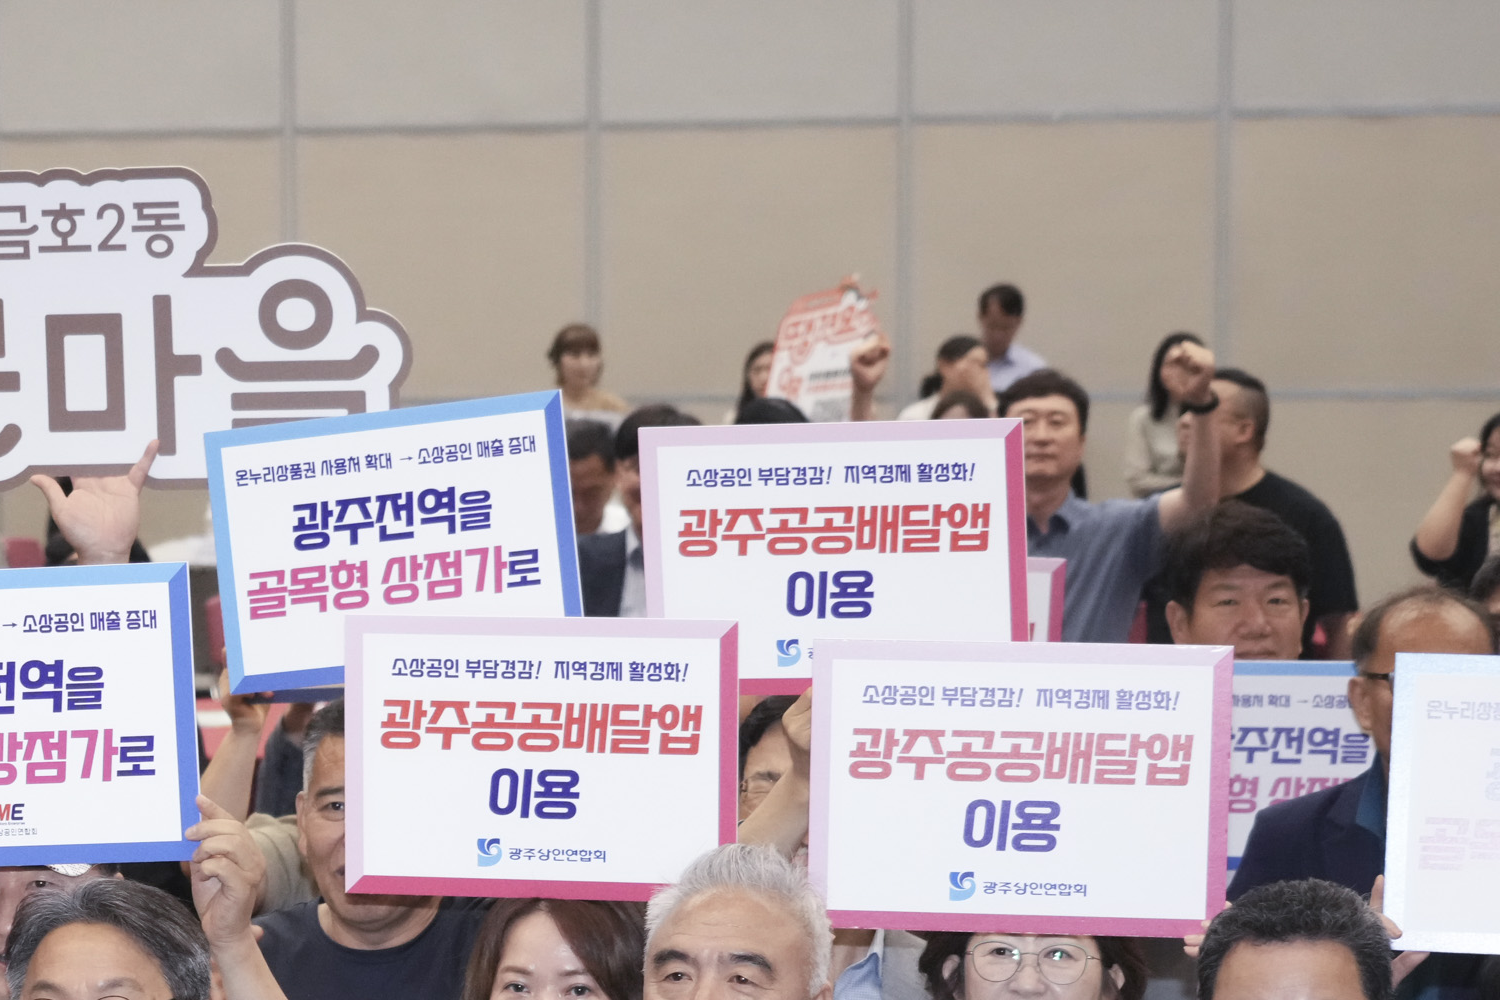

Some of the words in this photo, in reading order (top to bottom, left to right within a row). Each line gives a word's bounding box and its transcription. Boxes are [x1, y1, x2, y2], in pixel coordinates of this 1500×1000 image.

[236, 462, 316, 486] 온누리상품권
[321, 456, 360, 475] 사용처
[365, 453, 392, 470] 확대
[419, 443, 472, 464] 소상공인
[477, 439, 503, 457] 매출
[509, 436, 535, 454] 증대
[687, 468, 751, 487] 소상공인
[758, 467, 832, 486] 부담경감!
[844, 464, 911, 484] 지역경제
[917, 462, 975, 482] 활성화!
[292, 486, 493, 551] 광주전역을
[678, 503, 990, 557] 광주공공배달앱
[247, 560, 369, 620] 골목형
[382, 546, 541, 604] 상점가로
[787, 571, 874, 619] 이용
[23, 613, 84, 633] 소상공인
[90, 611, 120, 631] 매출
[126, 610, 156, 629] 증대
[392, 659, 458, 678] 소상공인
[465, 660, 541, 679] 부담경감!
[555, 661, 622, 681] 지역경제
[629, 661, 688, 682] 활성화!
[863, 685, 934, 706] 소상공인
[942, 687, 1023, 707] 부담경감!
[1037, 689, 1109, 709] 지역경제
[1116, 689, 1180, 711] 활성화!
[1312, 694, 1354, 709] 소상공
[381, 700, 703, 755] 광주공공배달앱
[1231, 726, 1370, 765] 주전역을
[849, 728, 1194, 786] 광주공공배달앱
[489, 768, 580, 819] 이용
[963, 799, 1060, 852] 이용
[509, 848, 606, 862] 광주상인연합회
[984, 882, 1086, 897] 광주상인연합회
